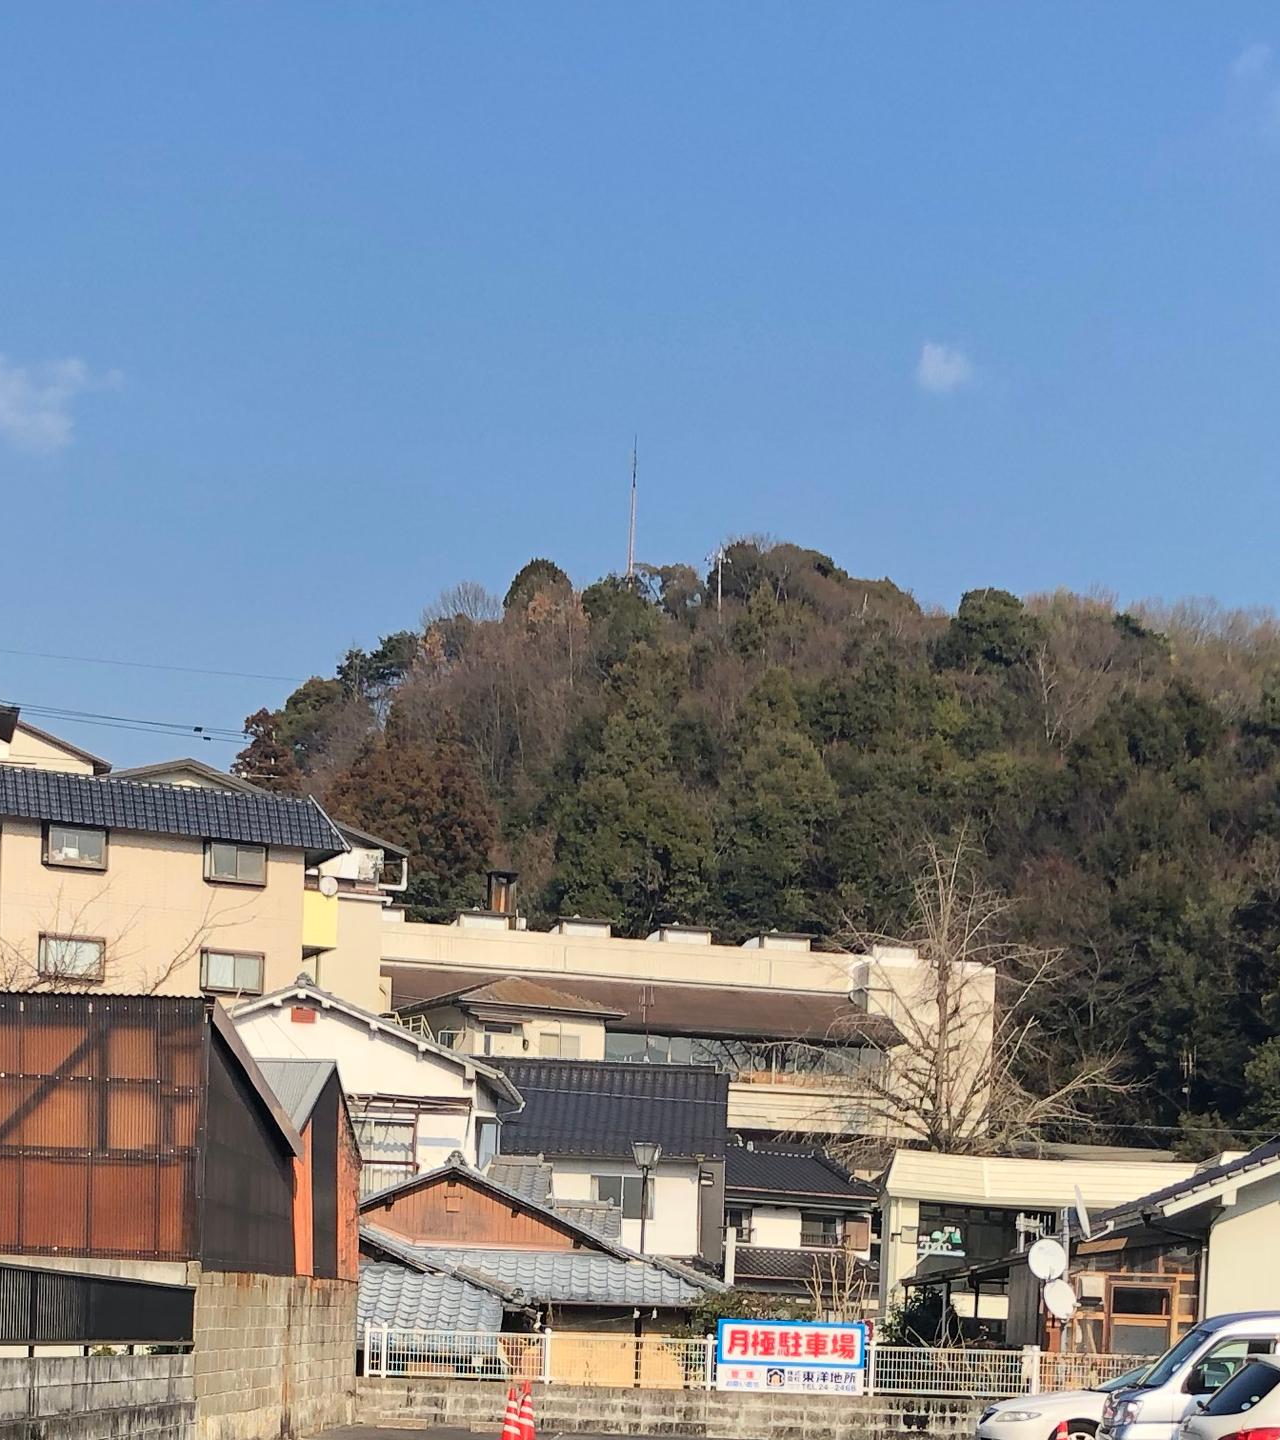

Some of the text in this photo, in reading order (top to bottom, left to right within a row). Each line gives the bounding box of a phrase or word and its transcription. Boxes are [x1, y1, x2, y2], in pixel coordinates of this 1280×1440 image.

[728, 1329, 856, 1360] 月極駐車場
[802, 1371, 856, 1384] 東洋地所
